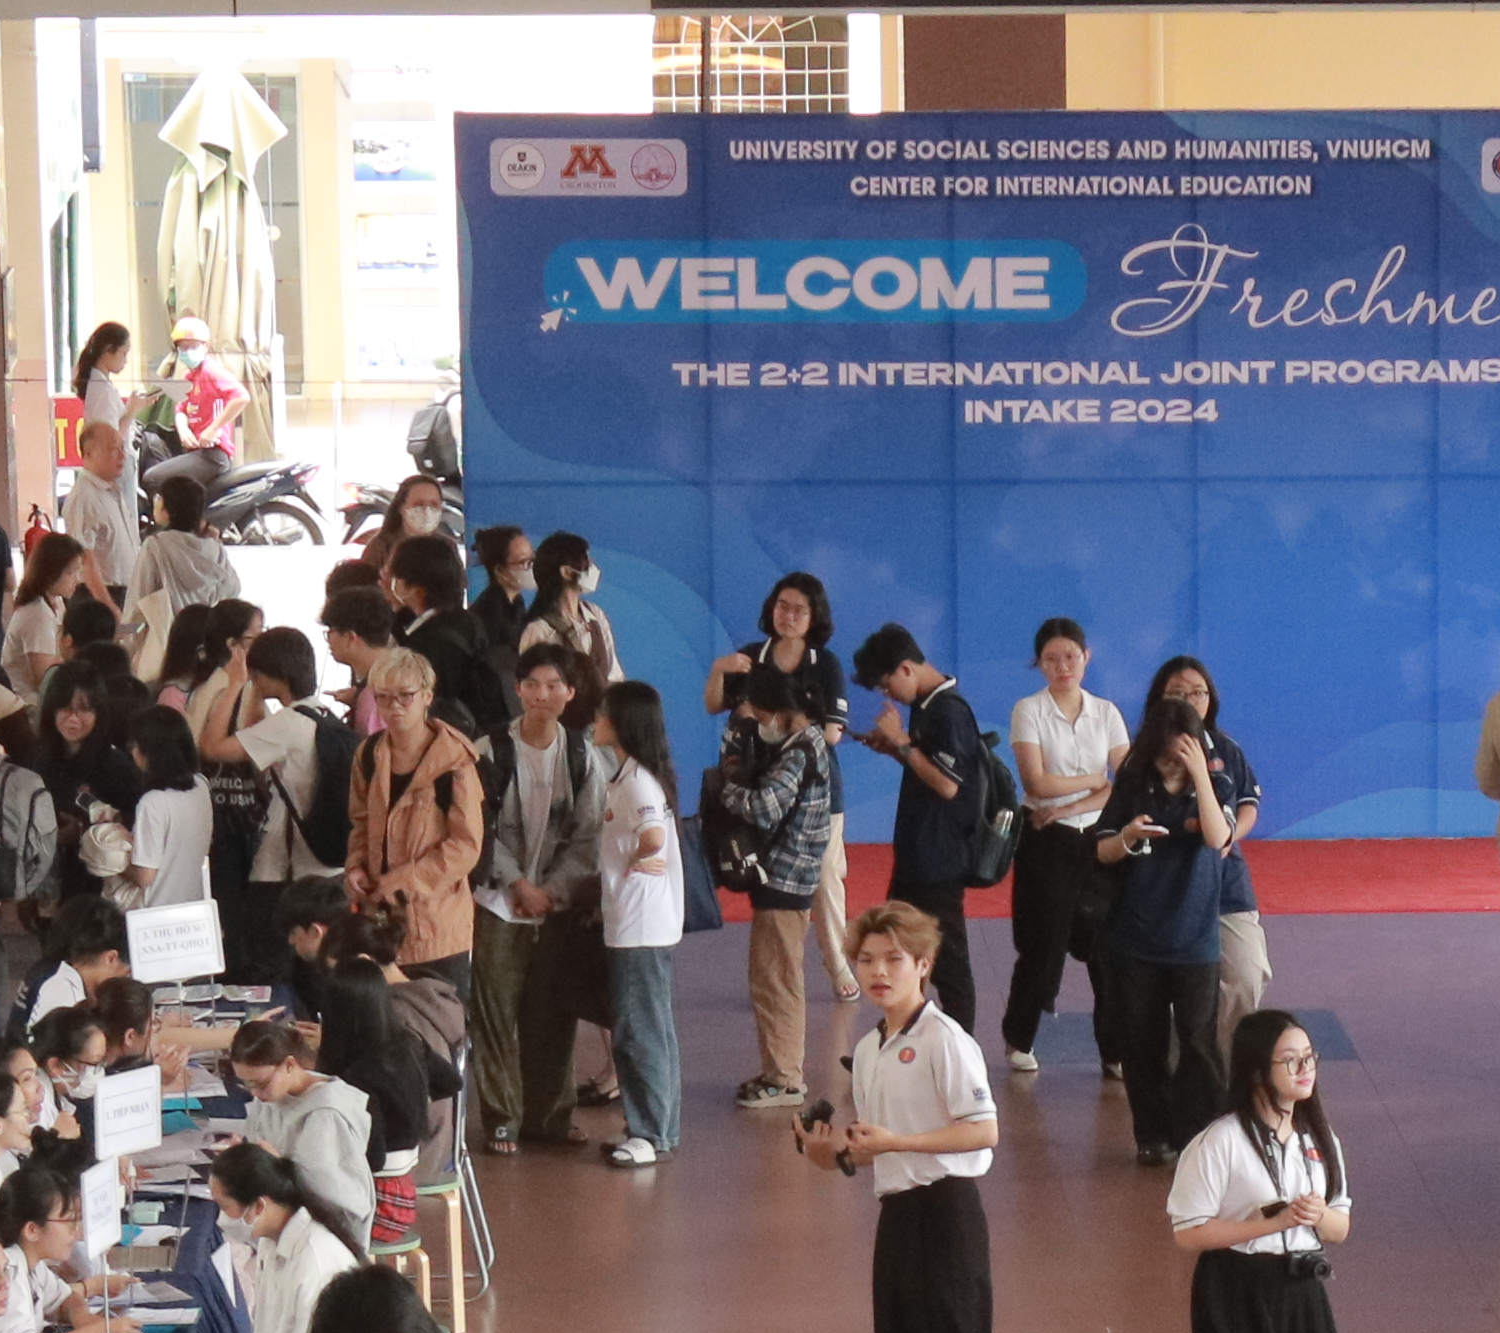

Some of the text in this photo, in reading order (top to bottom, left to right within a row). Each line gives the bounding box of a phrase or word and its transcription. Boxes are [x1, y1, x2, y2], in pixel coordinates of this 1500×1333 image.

[729, 138, 1431, 162] UNIVERSITY OF SOCIAL SCIENCES AND HUMANITIES, VNUHCM
[507, 164, 537, 172] DEAKIN
[850, 175, 1312, 196] CENTER FOR INTERNATIONAL EDUCATION
[576, 256, 1050, 312] WELCOME
[672, 362, 751, 387] THE
[760, 362, 829, 387] 2+2
[838, 360, 1150, 386] INTERNATIONAL
[1160, 360, 1276, 384] JOINT
[964, 398, 1219, 424] INTAKE 2024
